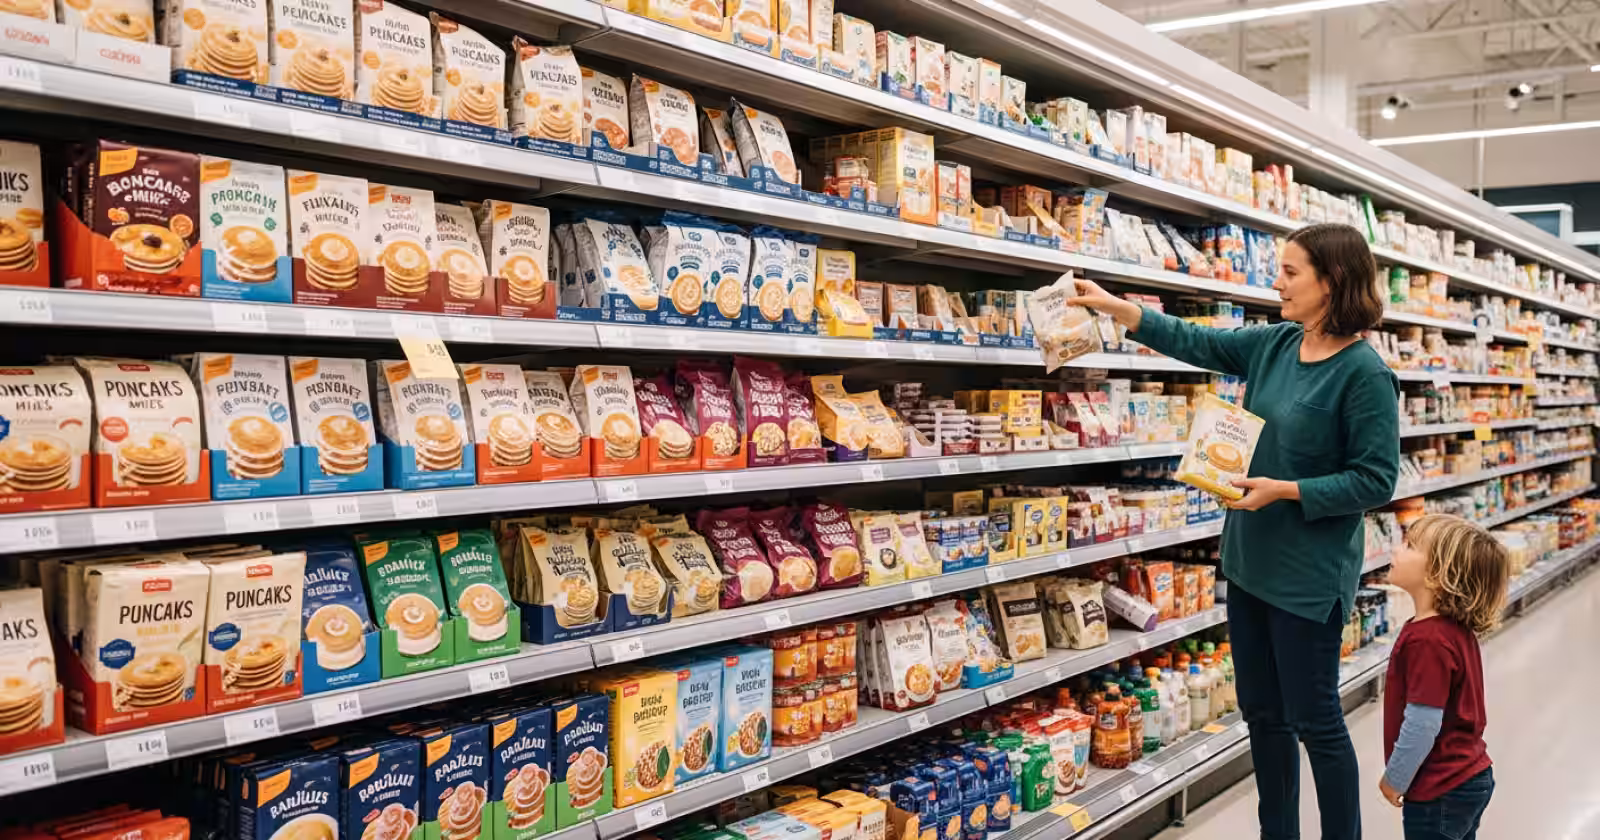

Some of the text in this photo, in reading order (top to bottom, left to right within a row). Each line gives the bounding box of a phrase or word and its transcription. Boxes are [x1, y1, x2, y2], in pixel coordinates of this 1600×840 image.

[105, 380, 184, 398] PONCAKS
[225, 584, 293, 611] PUNCAKS
[119, 600, 194, 624] PUNCAKS
